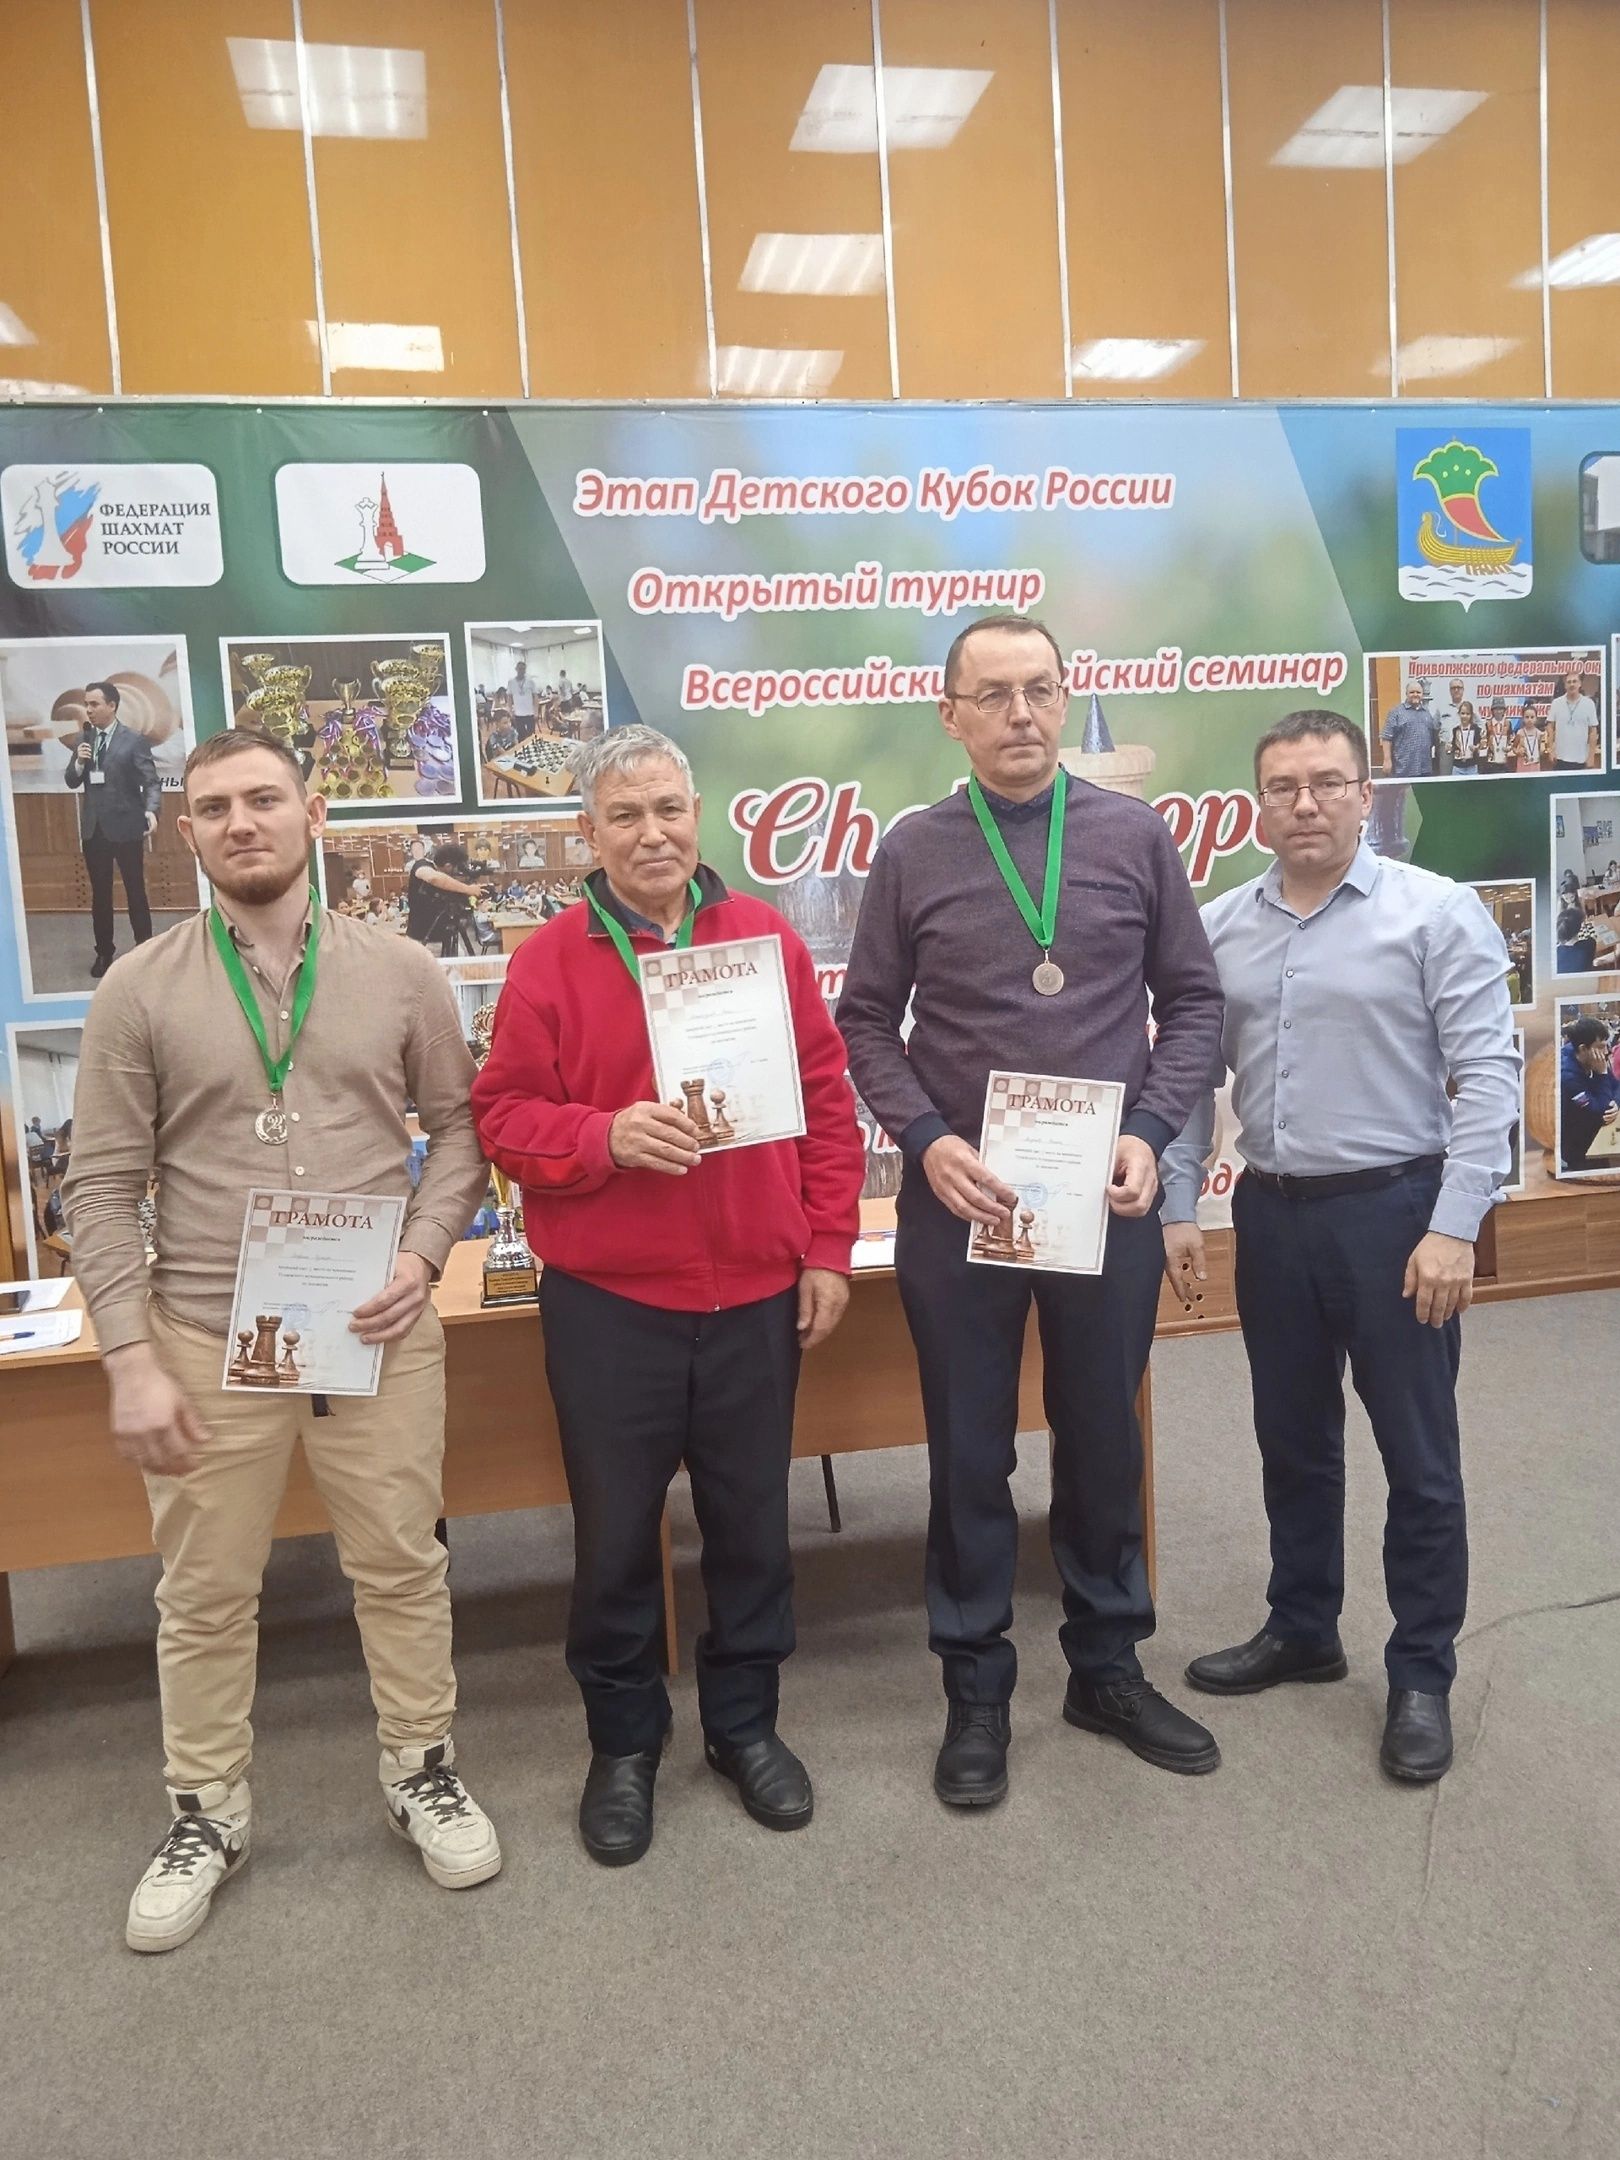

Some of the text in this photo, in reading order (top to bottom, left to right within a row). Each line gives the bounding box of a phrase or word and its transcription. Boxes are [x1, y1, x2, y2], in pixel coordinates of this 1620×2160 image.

[578, 470, 1172, 518] Этап Детского Кубок России
[100, 502, 211, 518] ФЕДЕРАЦИЯ
[101, 522, 184, 535] ШАХМАТ
[103, 541, 180, 555] РОССИИ
[632, 567, 1041, 616] Открытый турнир
[685, 661, 946, 711] Всероссийски
[1188, 655, 1342, 690] семинар
[668, 962, 757, 987] ГРАМОТА
[1010, 1094, 1096, 1115] ГРАМОТА
[275, 1211, 373, 1230] ГРАМОТА
